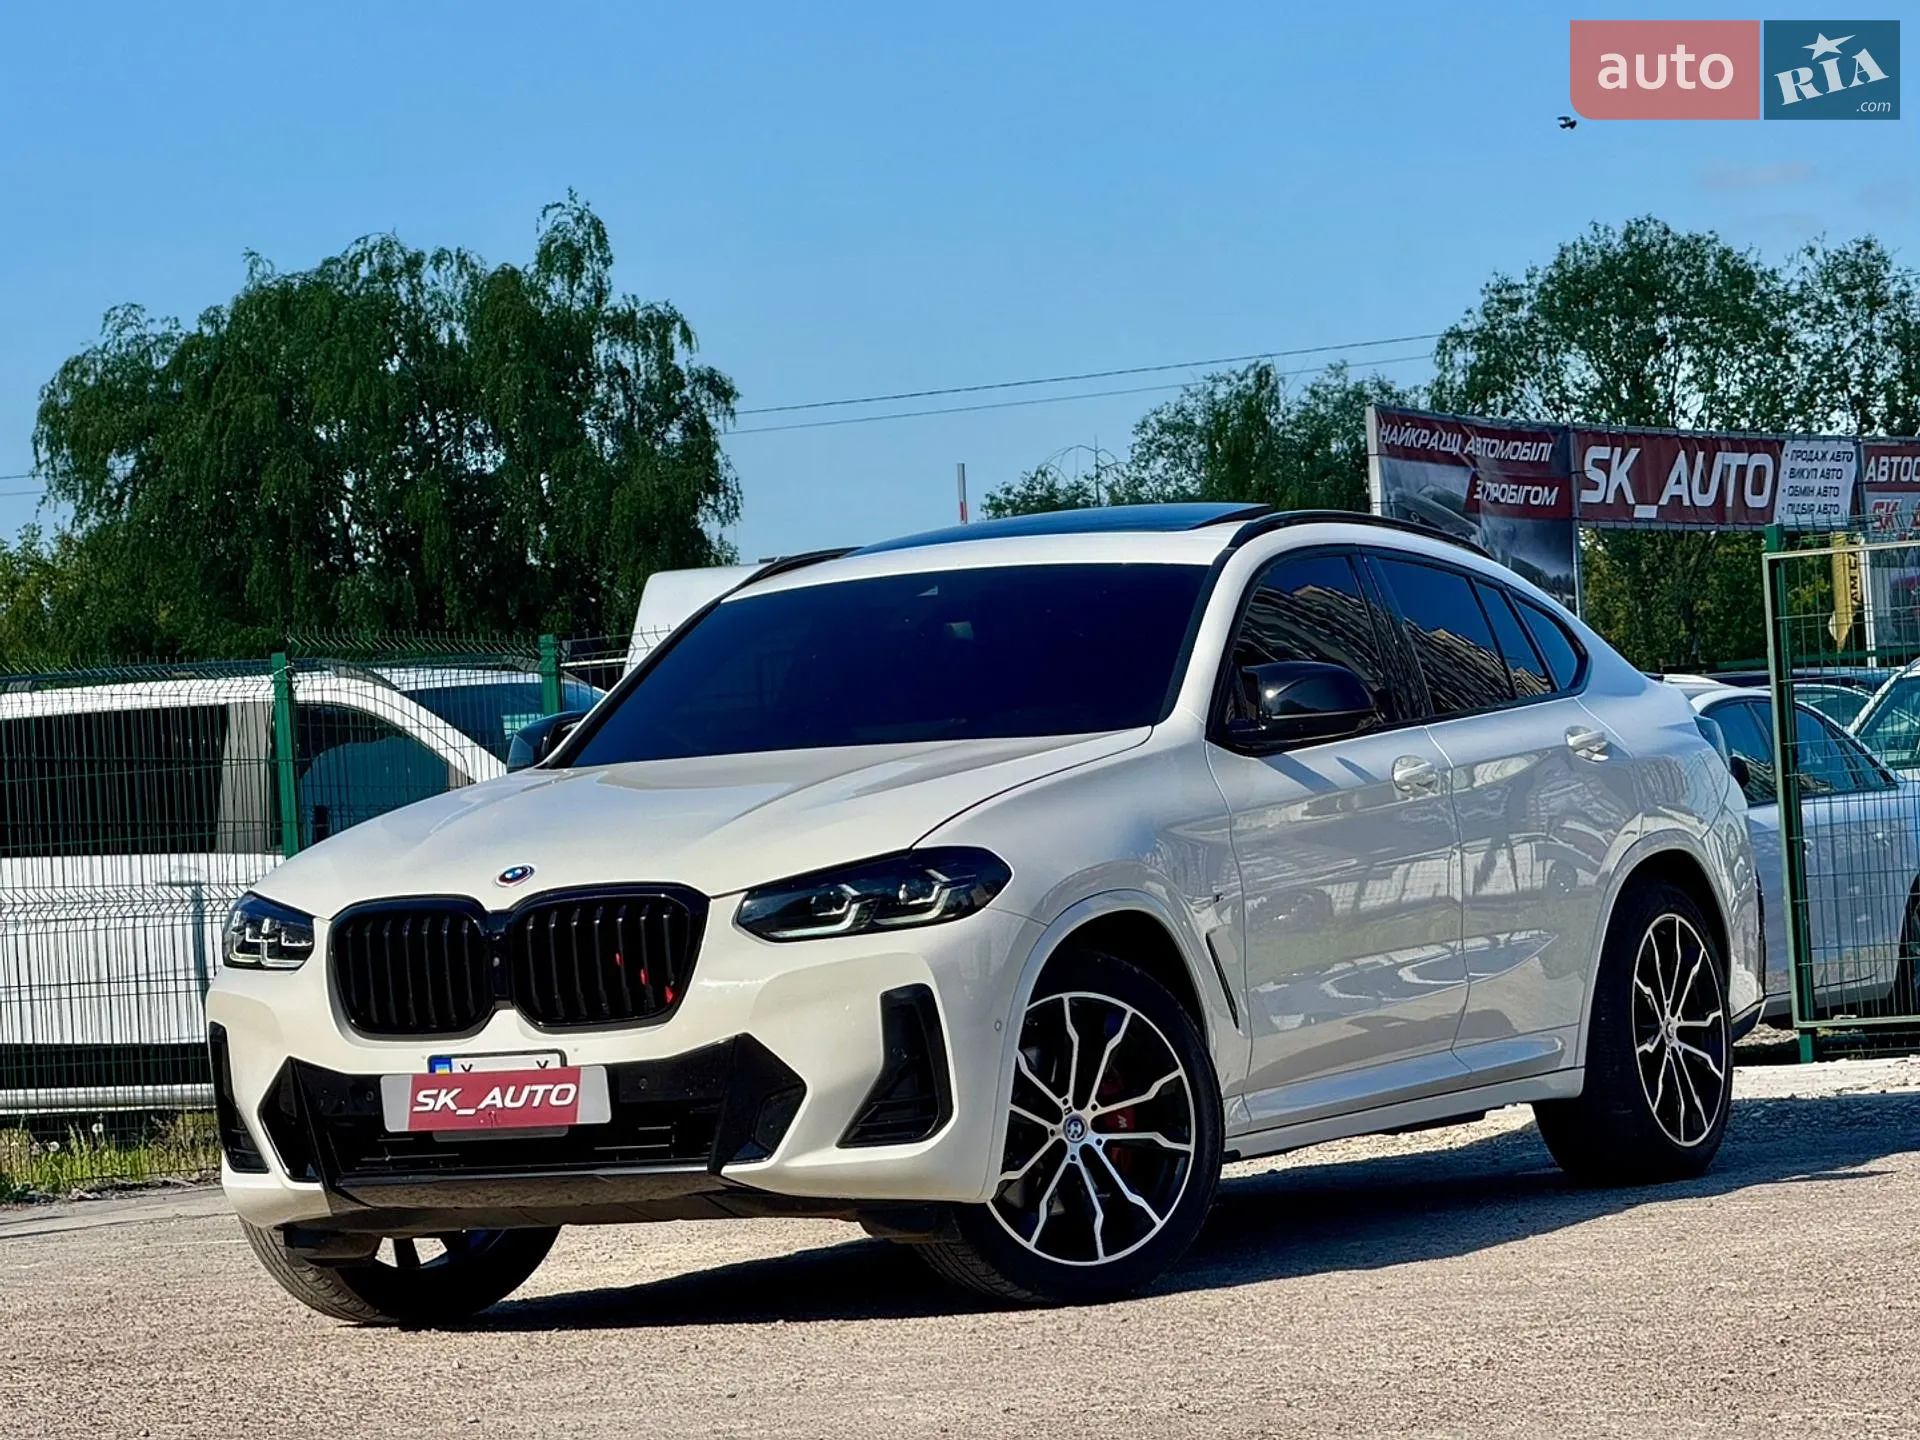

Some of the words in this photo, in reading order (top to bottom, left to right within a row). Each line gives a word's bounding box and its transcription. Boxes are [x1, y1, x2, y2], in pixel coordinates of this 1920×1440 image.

[1379, 422, 1462, 455] НАЙКРАЩІ
[1463, 436, 1553, 462] АВТОМОБІЛІ
[1829, 450, 1854, 462] АВТО
[1580, 446, 1775, 519] SK_AUTO
[1819, 468, 1843, 480] АВТО
[1816, 486, 1840, 498] АВТО
[412, 1083, 578, 1116] SK_AUTO
